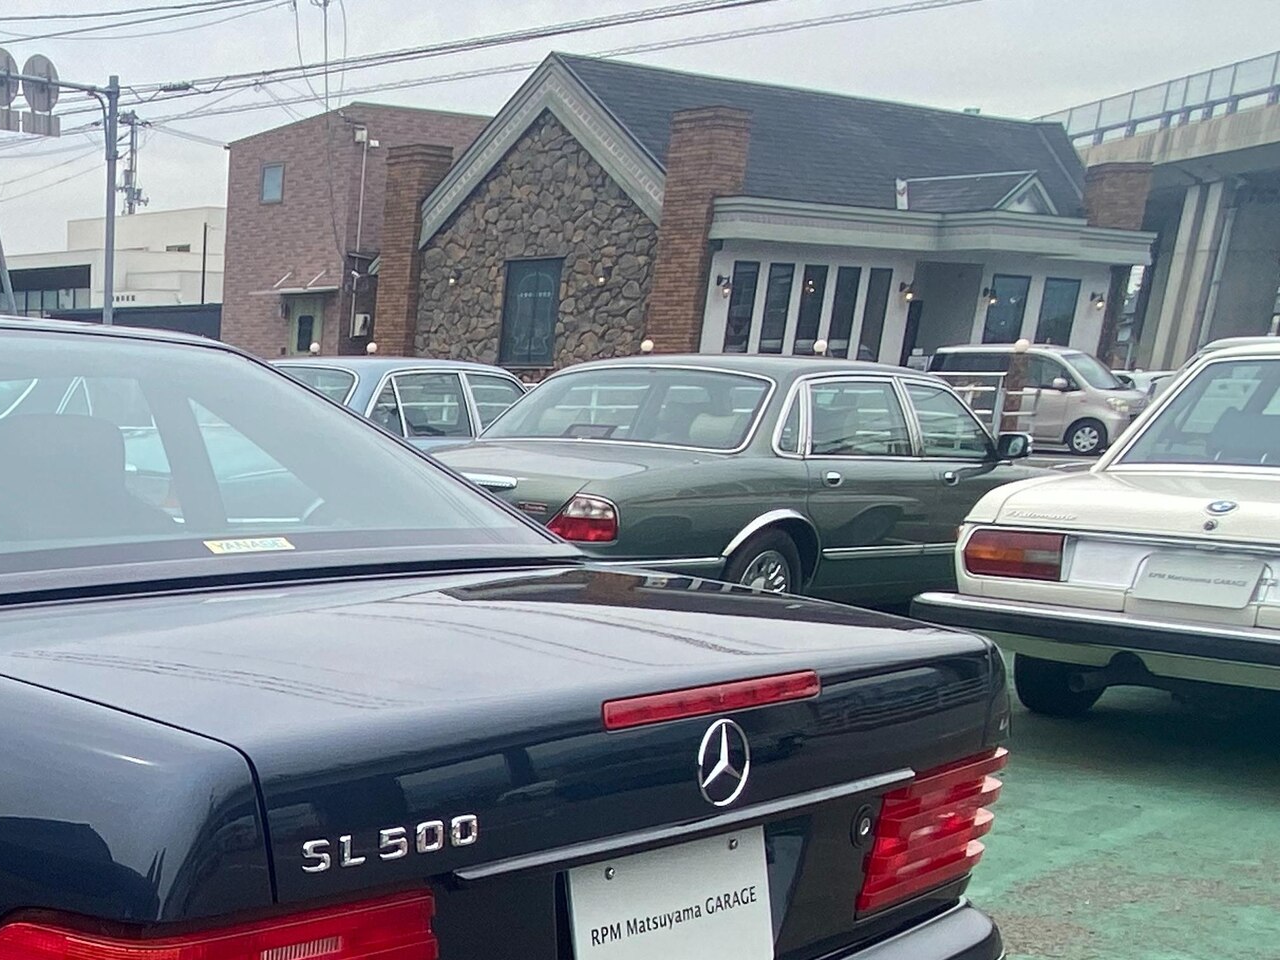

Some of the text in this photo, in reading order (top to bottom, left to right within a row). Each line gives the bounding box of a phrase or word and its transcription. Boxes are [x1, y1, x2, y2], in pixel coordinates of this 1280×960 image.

[301, 813, 478, 873] SL 500
[591, 886, 758, 947] RPM Matsuyama GARAGE
